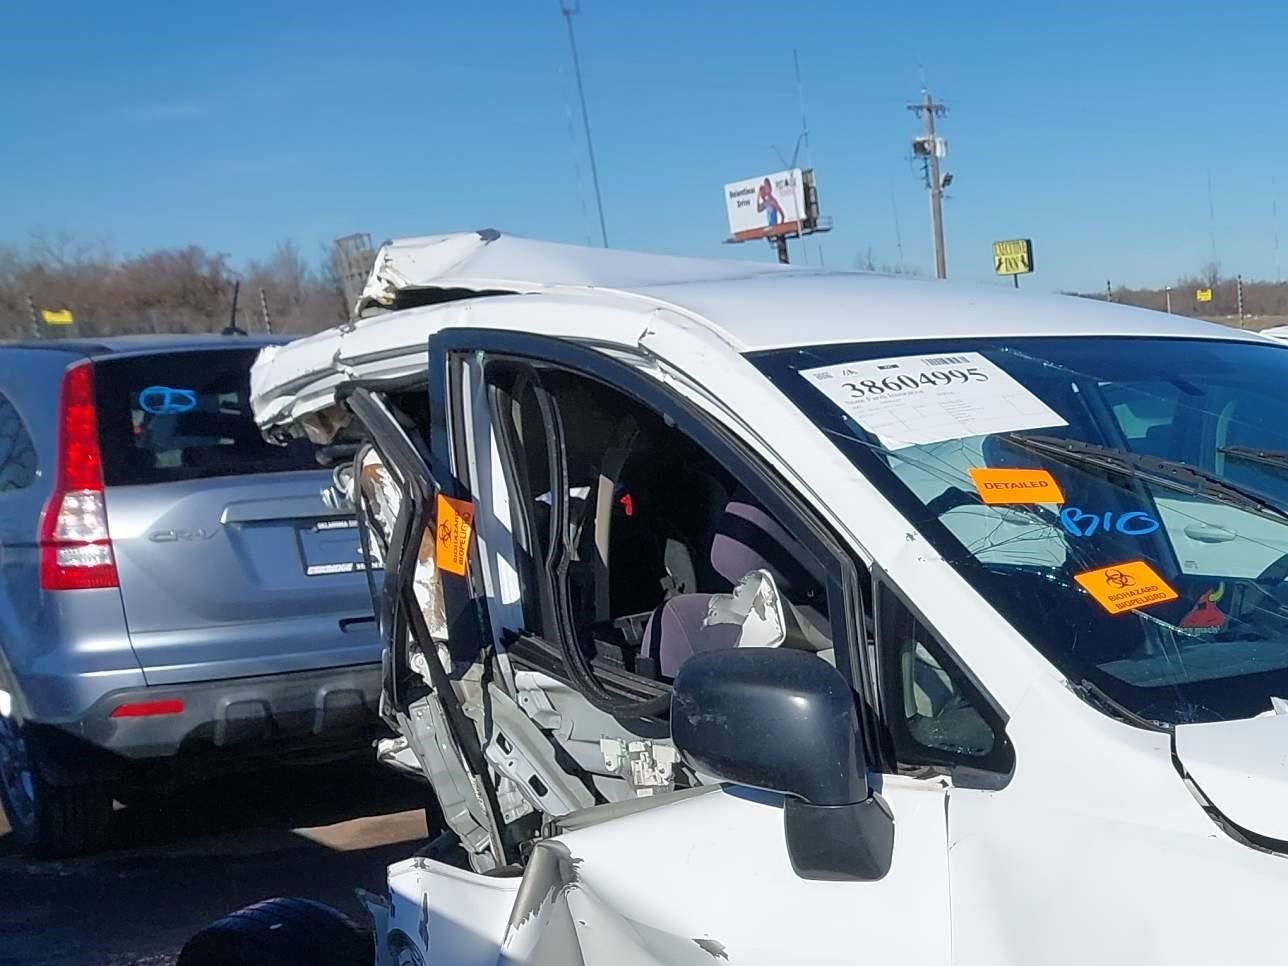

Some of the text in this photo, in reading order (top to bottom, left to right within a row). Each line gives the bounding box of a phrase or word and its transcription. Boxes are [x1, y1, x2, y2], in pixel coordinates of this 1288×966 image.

[841, 366, 989, 399] 38604995
[984, 480, 1049, 490] DETAILED
[1108, 585, 1160, 602] BIOHAZARD
